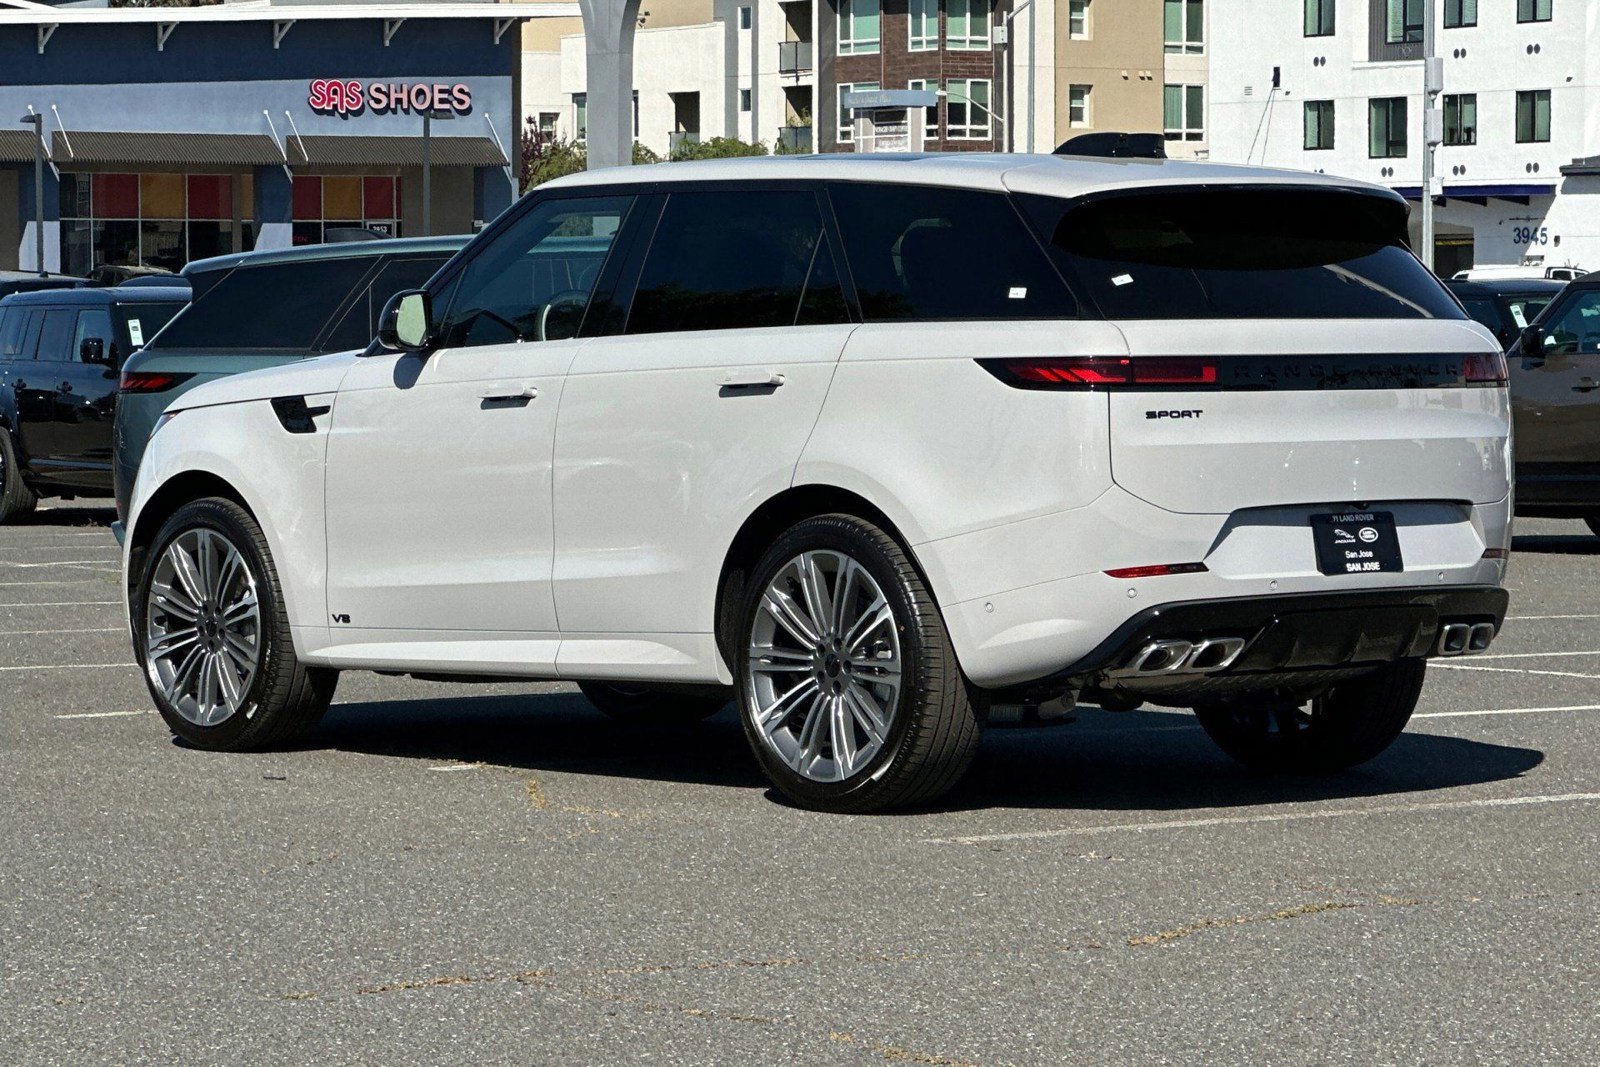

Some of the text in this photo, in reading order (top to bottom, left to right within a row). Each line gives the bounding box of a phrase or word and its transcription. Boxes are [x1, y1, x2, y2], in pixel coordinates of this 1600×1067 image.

[309, 79, 471, 114] SAS SHOES
[1513, 227, 1548, 246] 3945
[1145, 409, 1204, 419] SPORT
[1345, 549, 1374, 559] San Jose
[1346, 561, 1381, 572] SAN JOSE
[331, 614, 351, 623] V8
